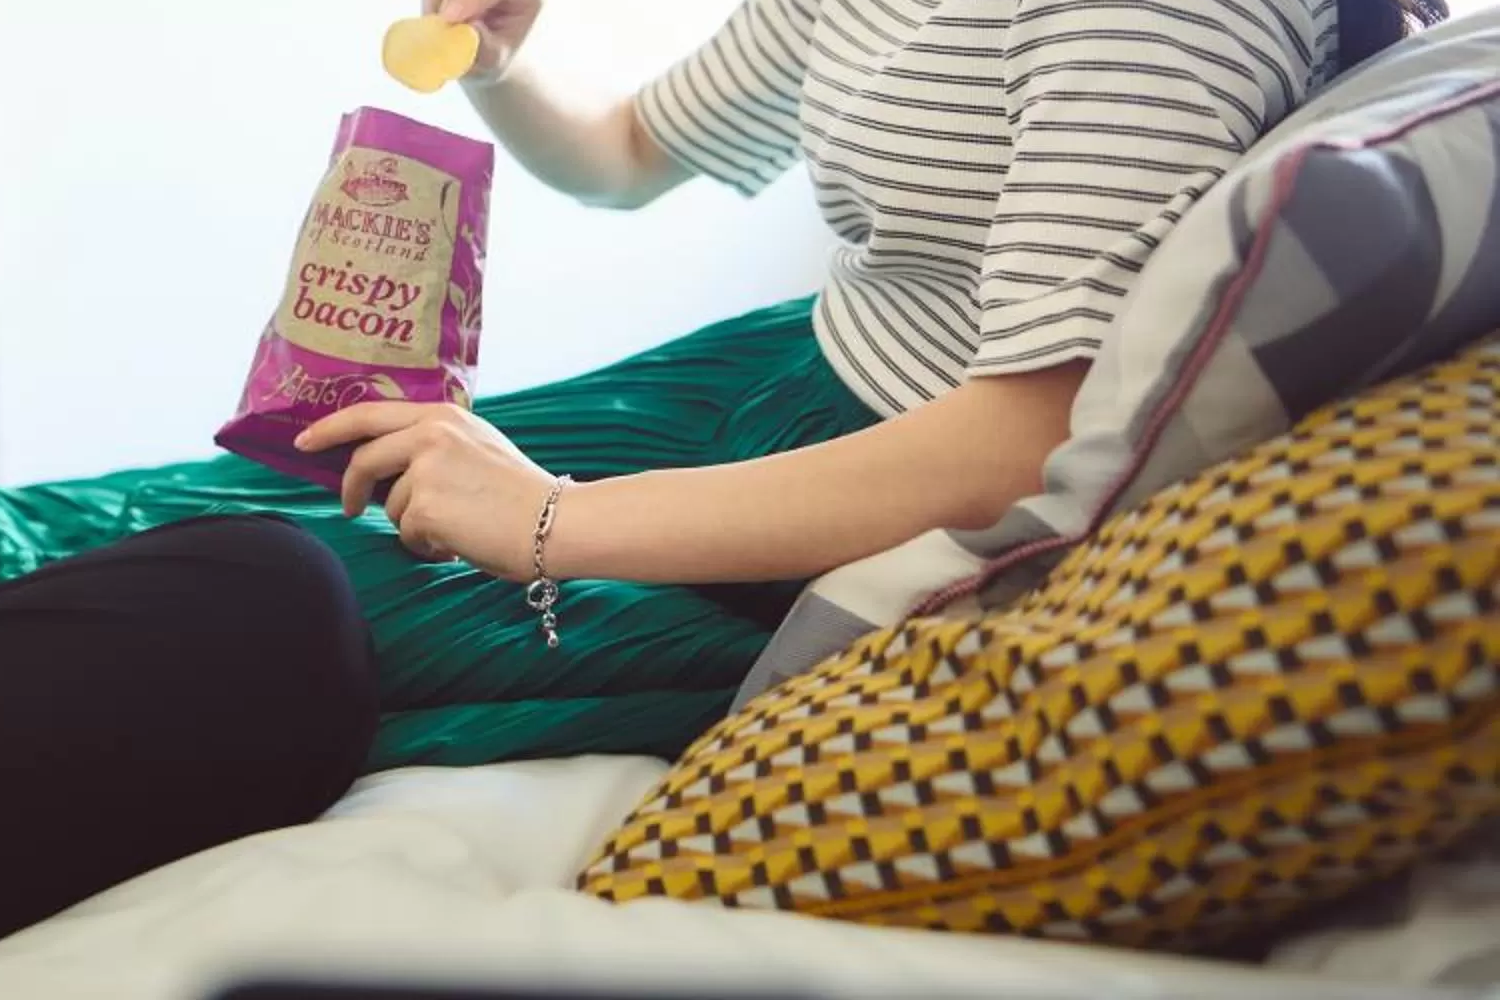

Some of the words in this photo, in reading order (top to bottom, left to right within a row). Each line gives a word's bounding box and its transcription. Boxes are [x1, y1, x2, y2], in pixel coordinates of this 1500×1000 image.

[331, 228, 428, 262] Scotland
[300, 260, 421, 311] crispy
[292, 285, 414, 343] bacon
